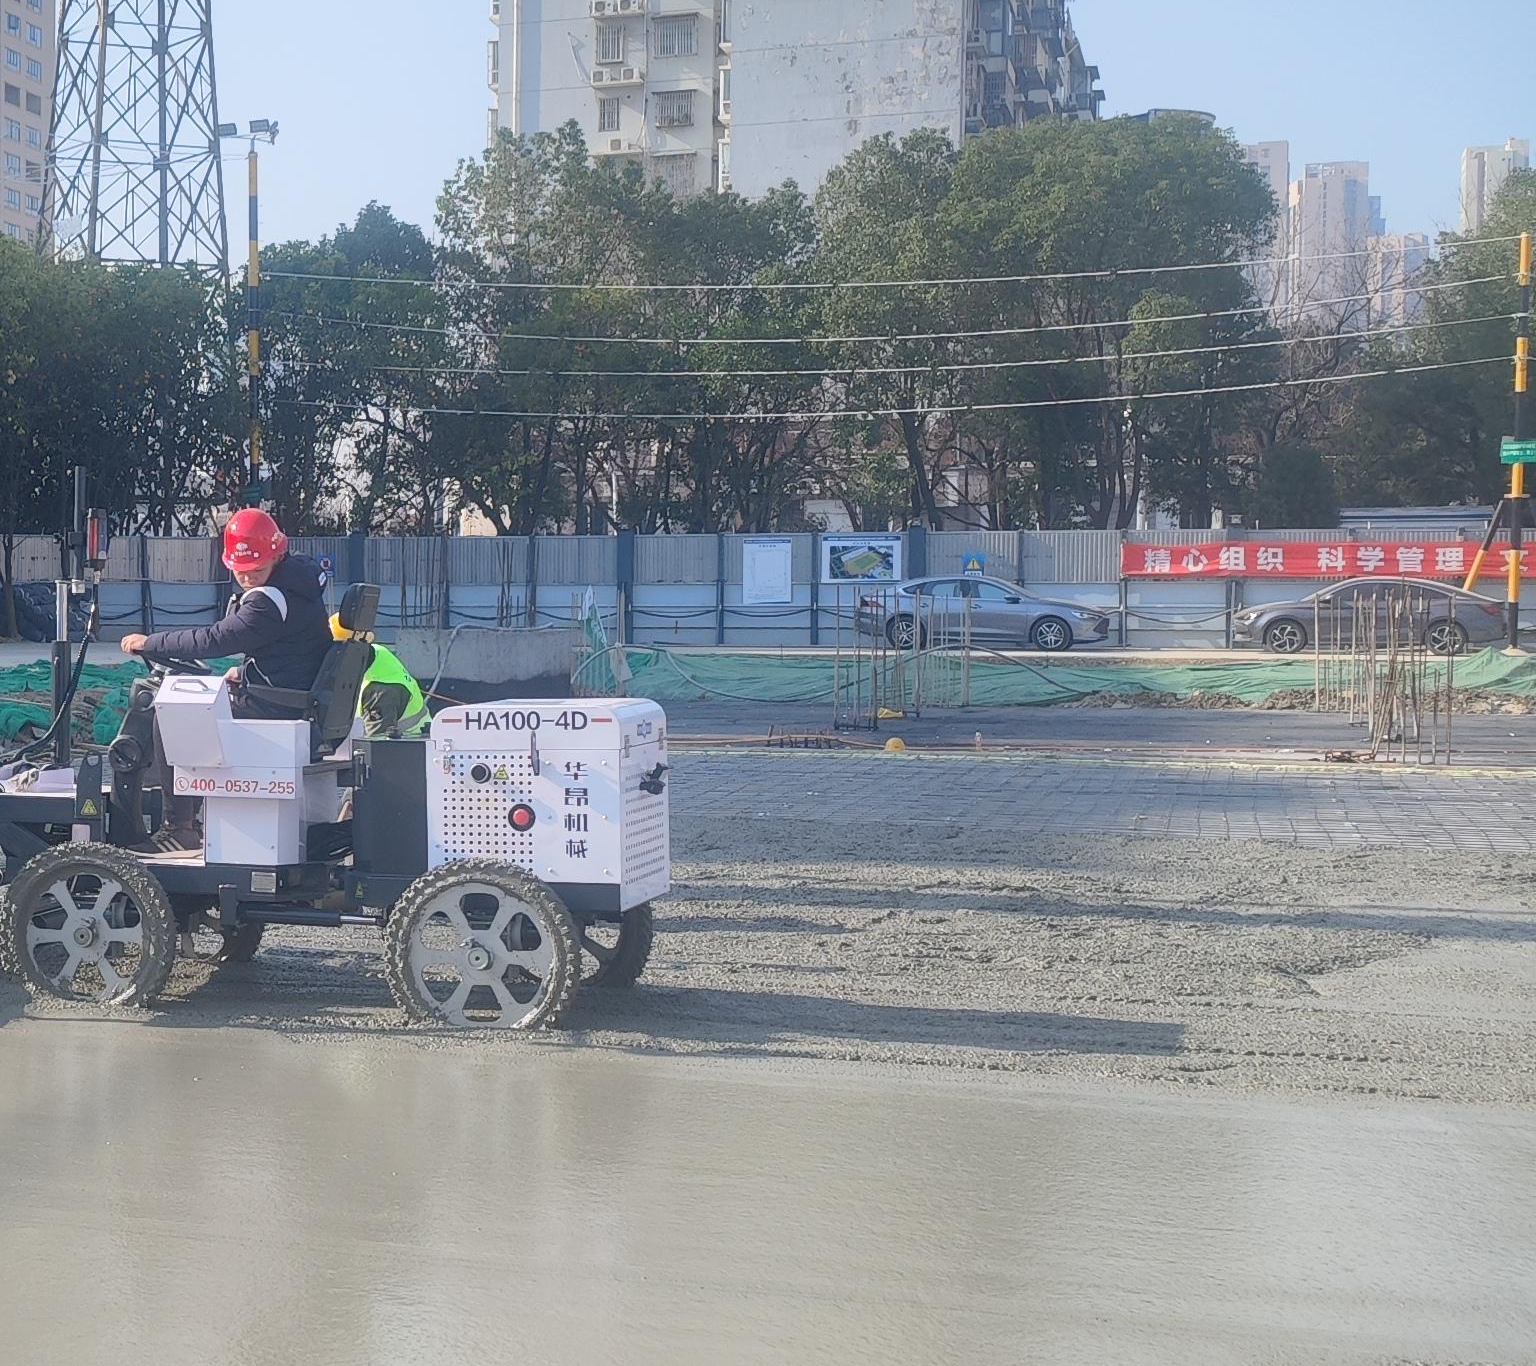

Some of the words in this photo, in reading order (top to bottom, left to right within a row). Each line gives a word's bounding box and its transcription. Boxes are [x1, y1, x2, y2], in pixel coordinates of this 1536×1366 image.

[1144, 546, 1284, 572] 精心组织
[1317, 546, 1464, 572] 科学管理
[465, 711, 588, 731] HA100-4D
[190, 778, 295, 795] 400-0537-255
[564, 761, 589, 859] 华昂机械
